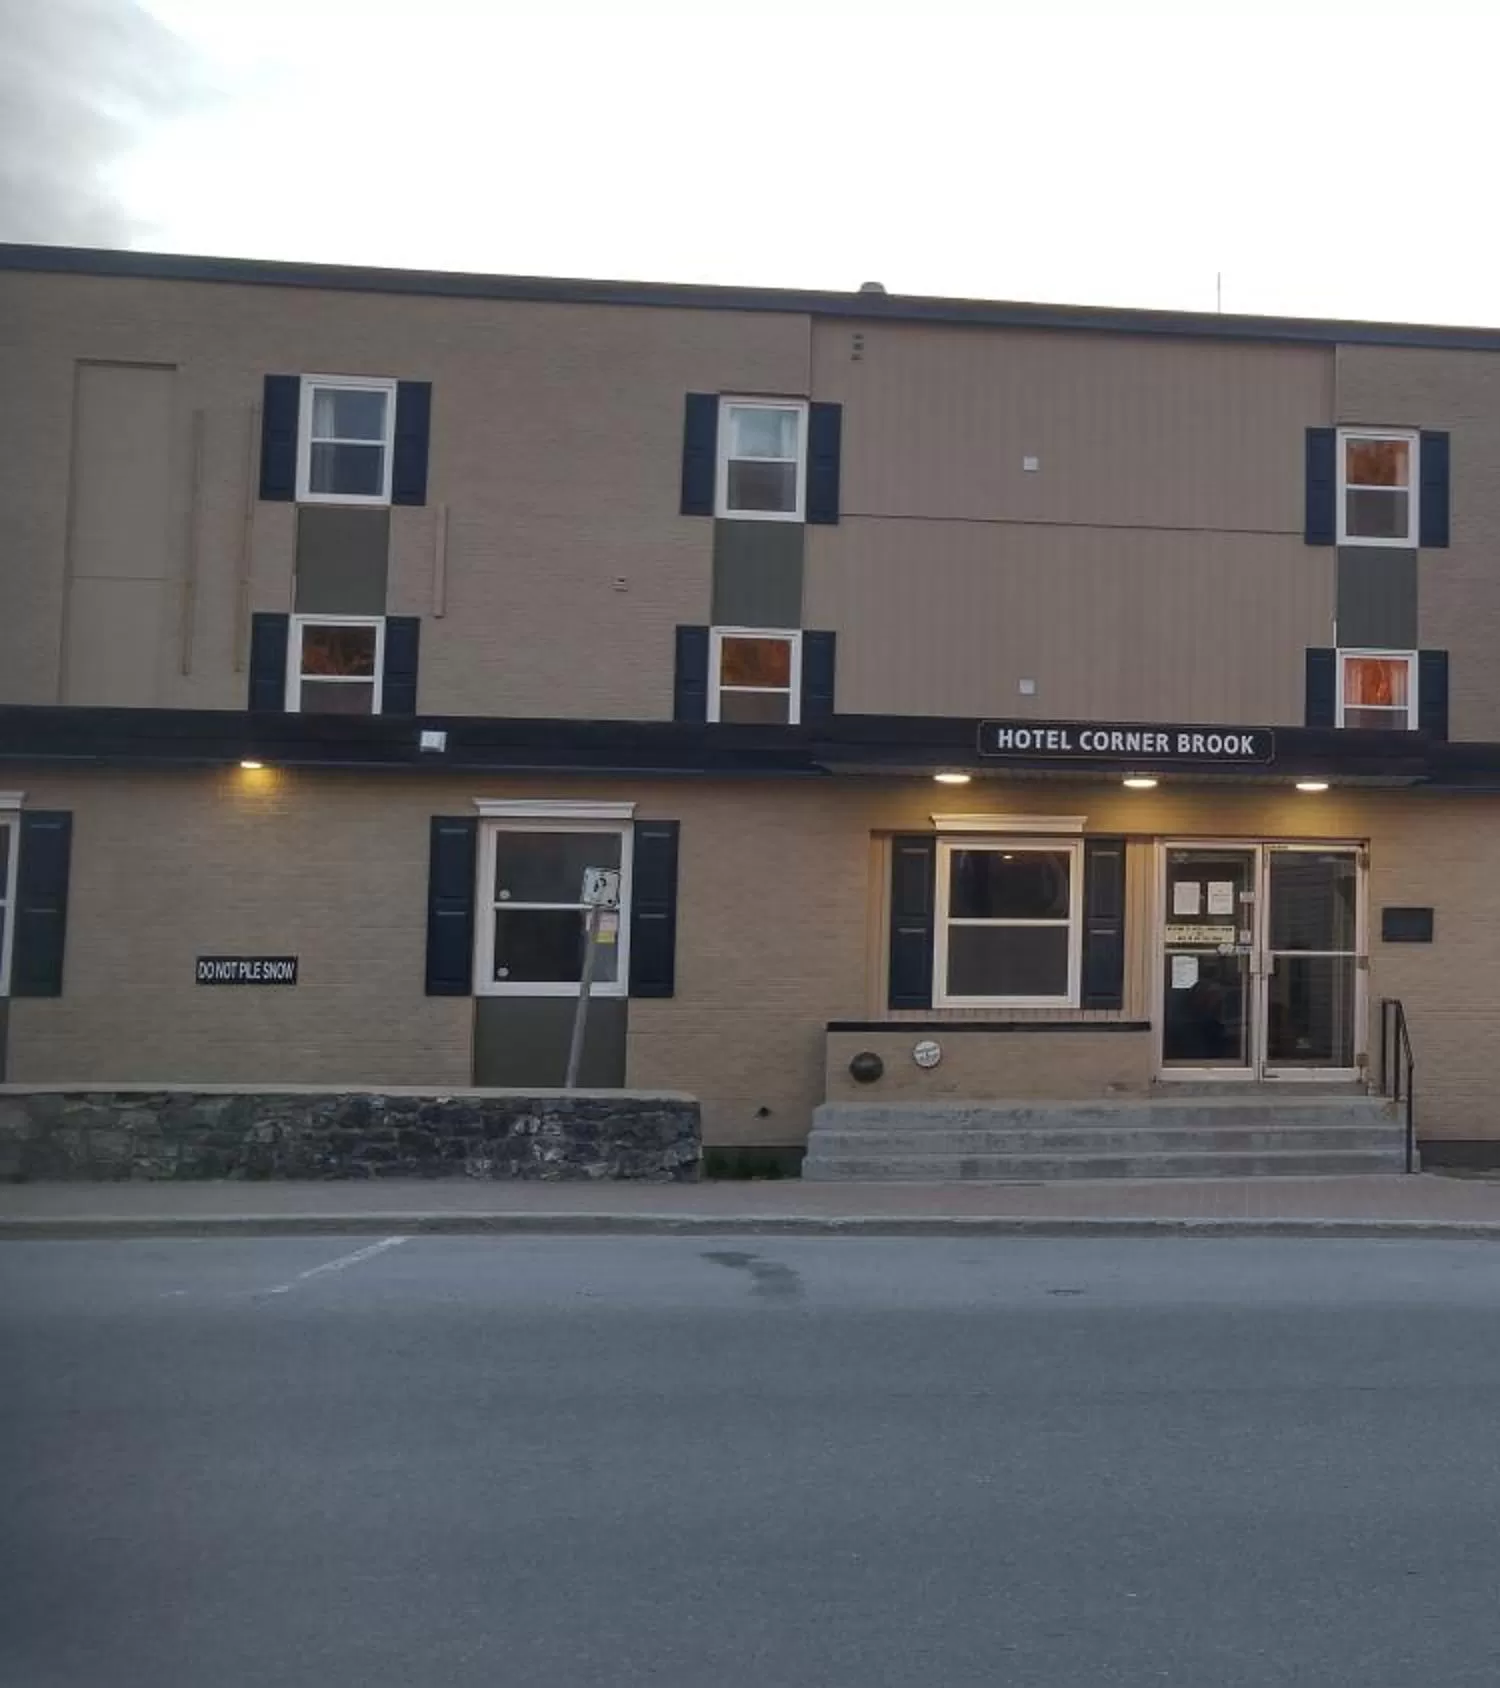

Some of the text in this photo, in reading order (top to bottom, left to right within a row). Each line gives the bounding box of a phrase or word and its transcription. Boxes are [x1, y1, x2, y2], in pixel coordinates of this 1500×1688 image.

[998, 729, 1255, 755] HOTEL CORNER BROOK
[198, 961, 295, 979] DO NOT PILE SNOW
